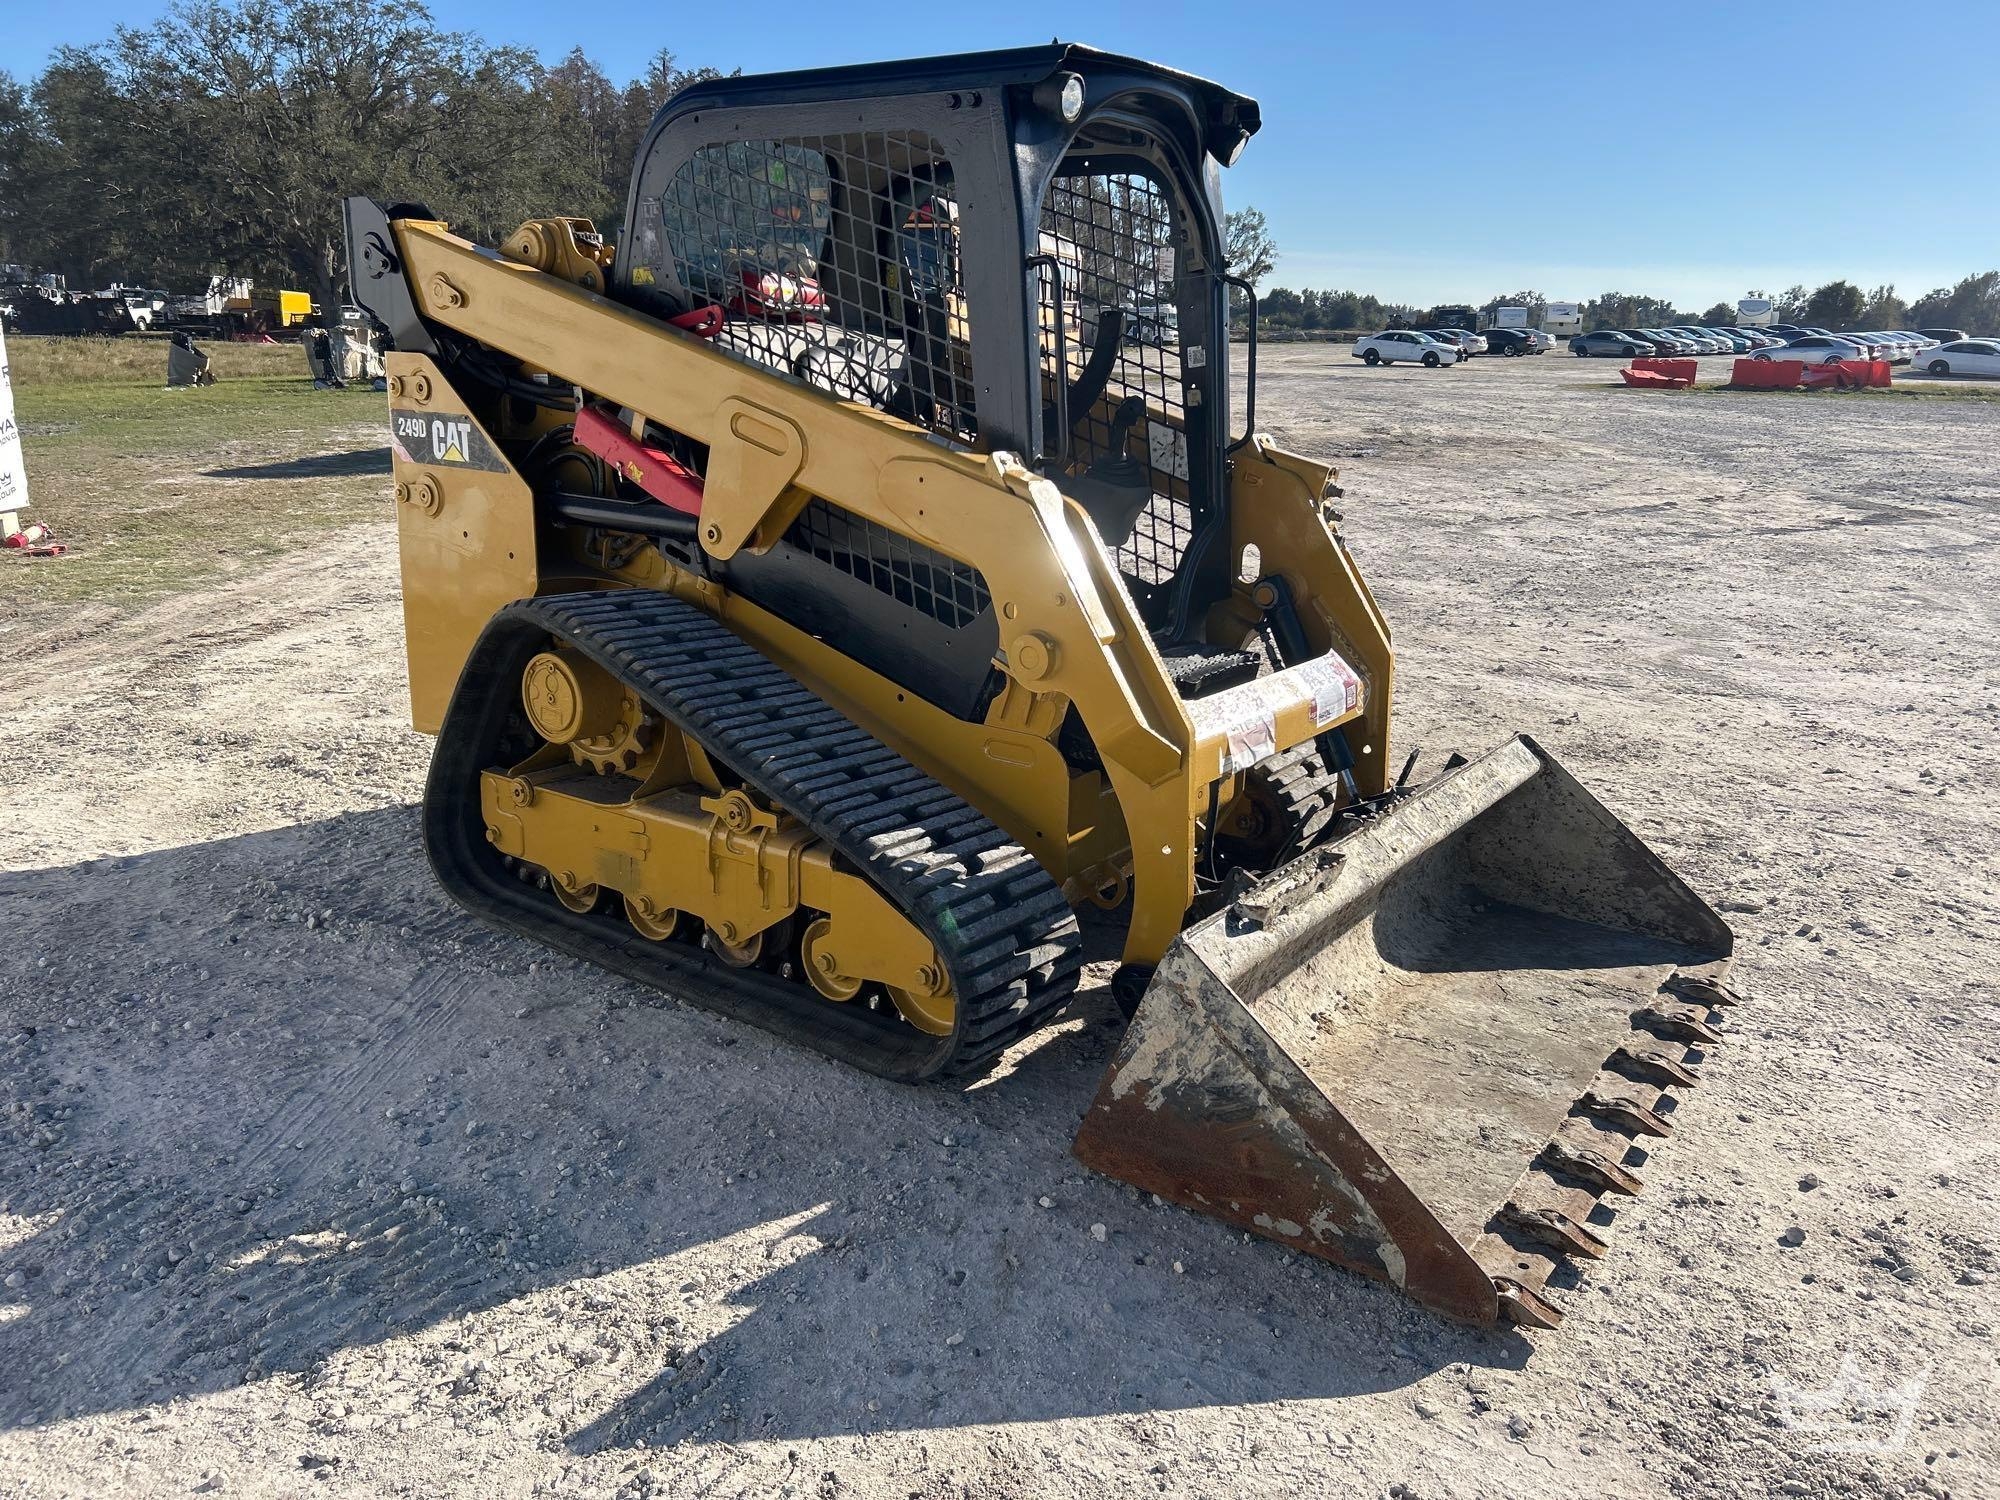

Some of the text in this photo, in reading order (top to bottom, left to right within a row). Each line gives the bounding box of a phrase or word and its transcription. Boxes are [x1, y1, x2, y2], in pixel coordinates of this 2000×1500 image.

[398, 416, 471, 463] 249D CAT
[0, 486, 17, 500] OUP
